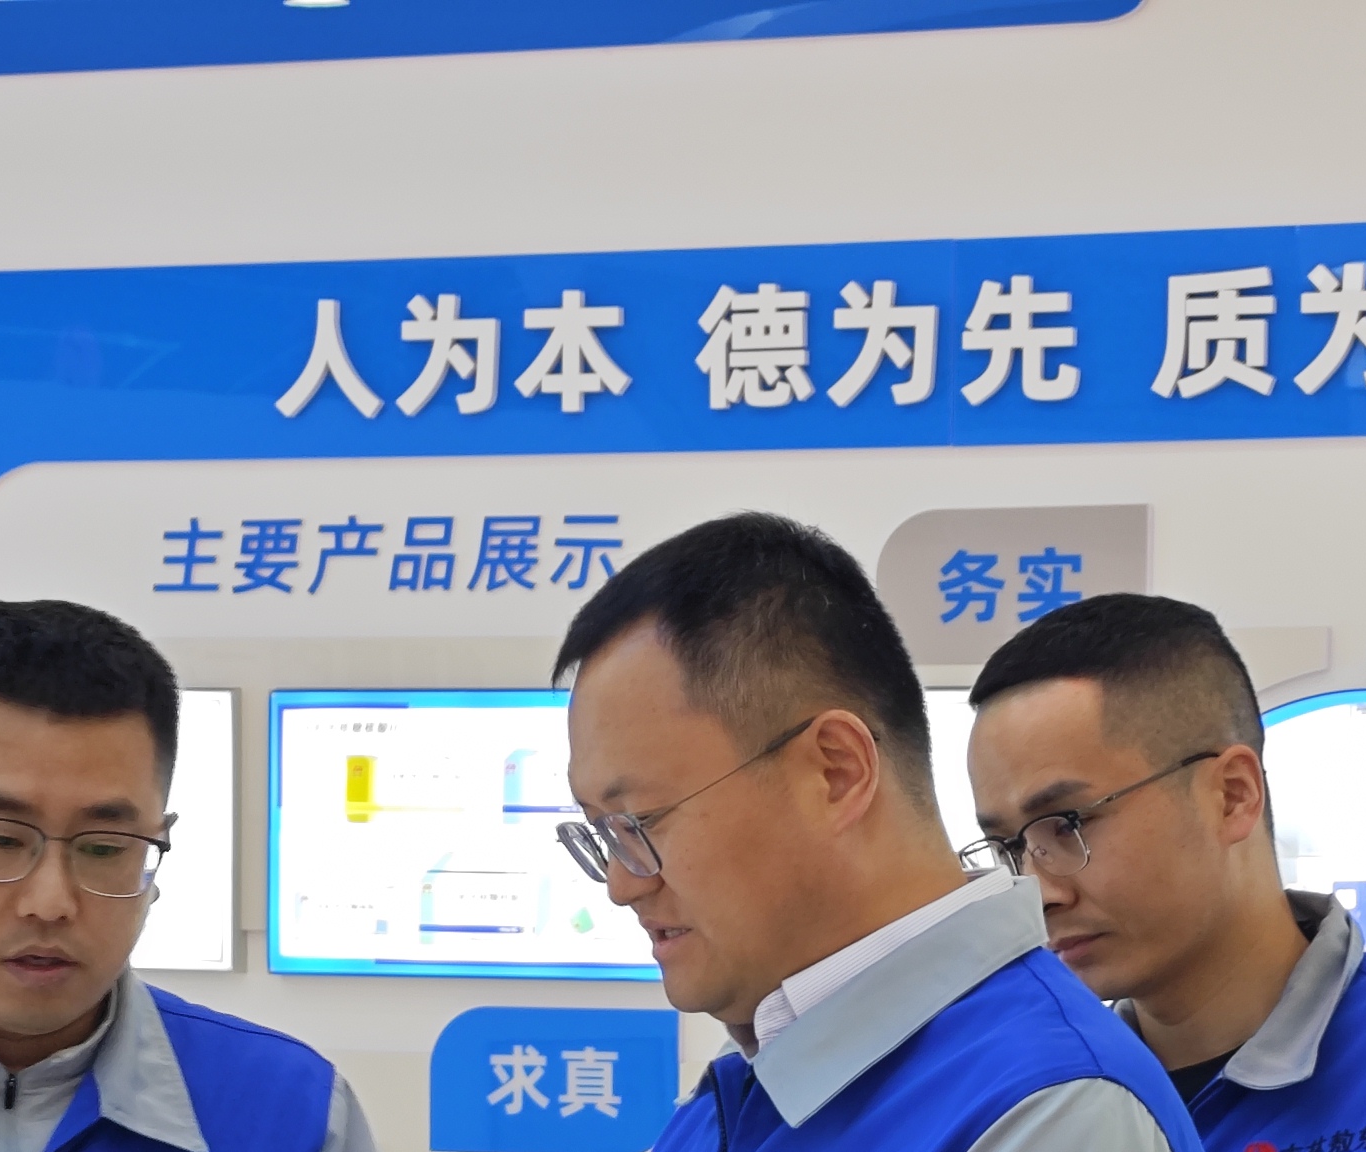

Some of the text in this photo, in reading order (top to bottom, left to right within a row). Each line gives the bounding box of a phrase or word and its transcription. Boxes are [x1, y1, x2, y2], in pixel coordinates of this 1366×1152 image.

[273, 288, 632, 419] 人为本
[695, 274, 1081, 411] 德为先
[153, 515, 623, 594] 主要产品展示
[937, 546, 1084, 624] 务实
[486, 1044, 623, 1119] 求真
